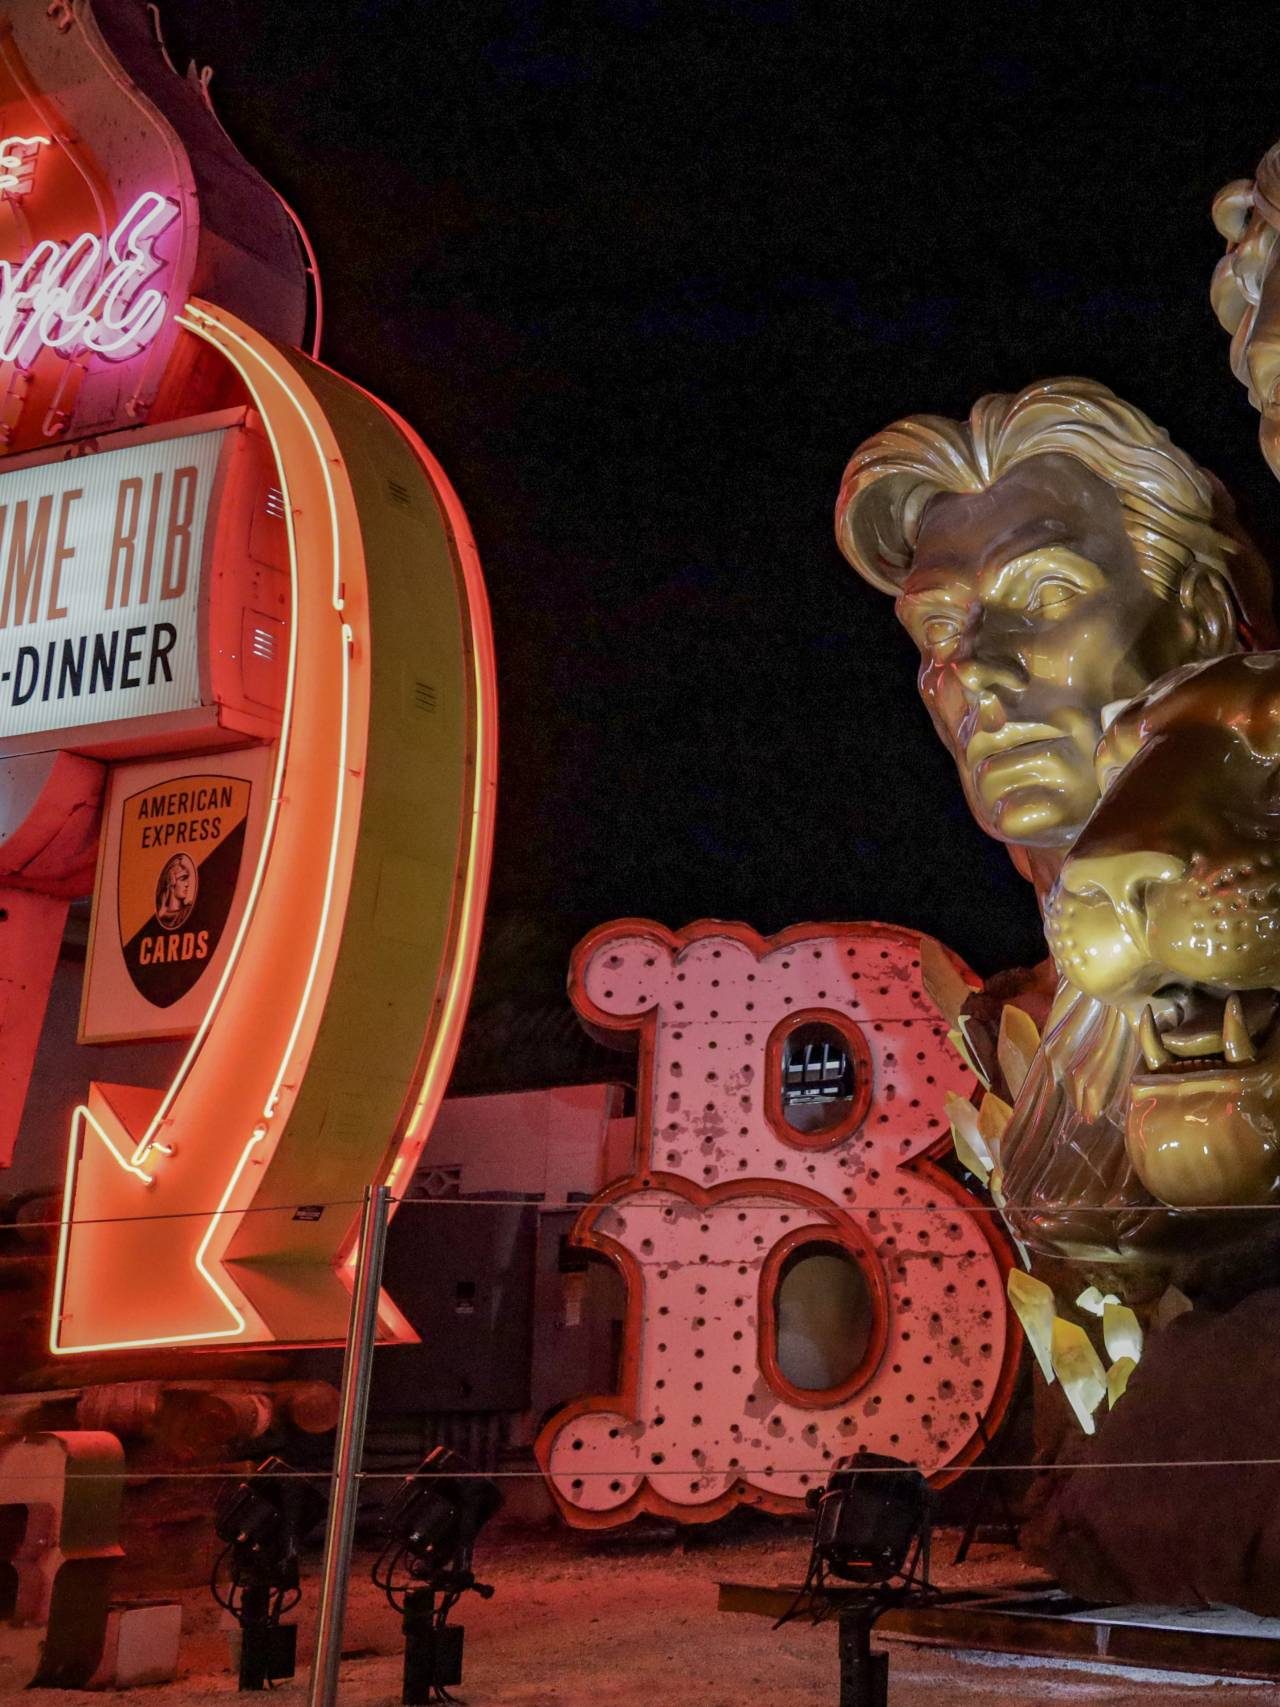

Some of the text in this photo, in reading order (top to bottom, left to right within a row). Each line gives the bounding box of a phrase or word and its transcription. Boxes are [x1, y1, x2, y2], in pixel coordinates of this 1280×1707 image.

[104, 465, 199, 611] RIB
[139, 787, 232, 819] AMERICAN
[142, 817, 221, 848] EXPRESS
[140, 931, 208, 965] CARDS
[534, 917, 1022, 1531] B
